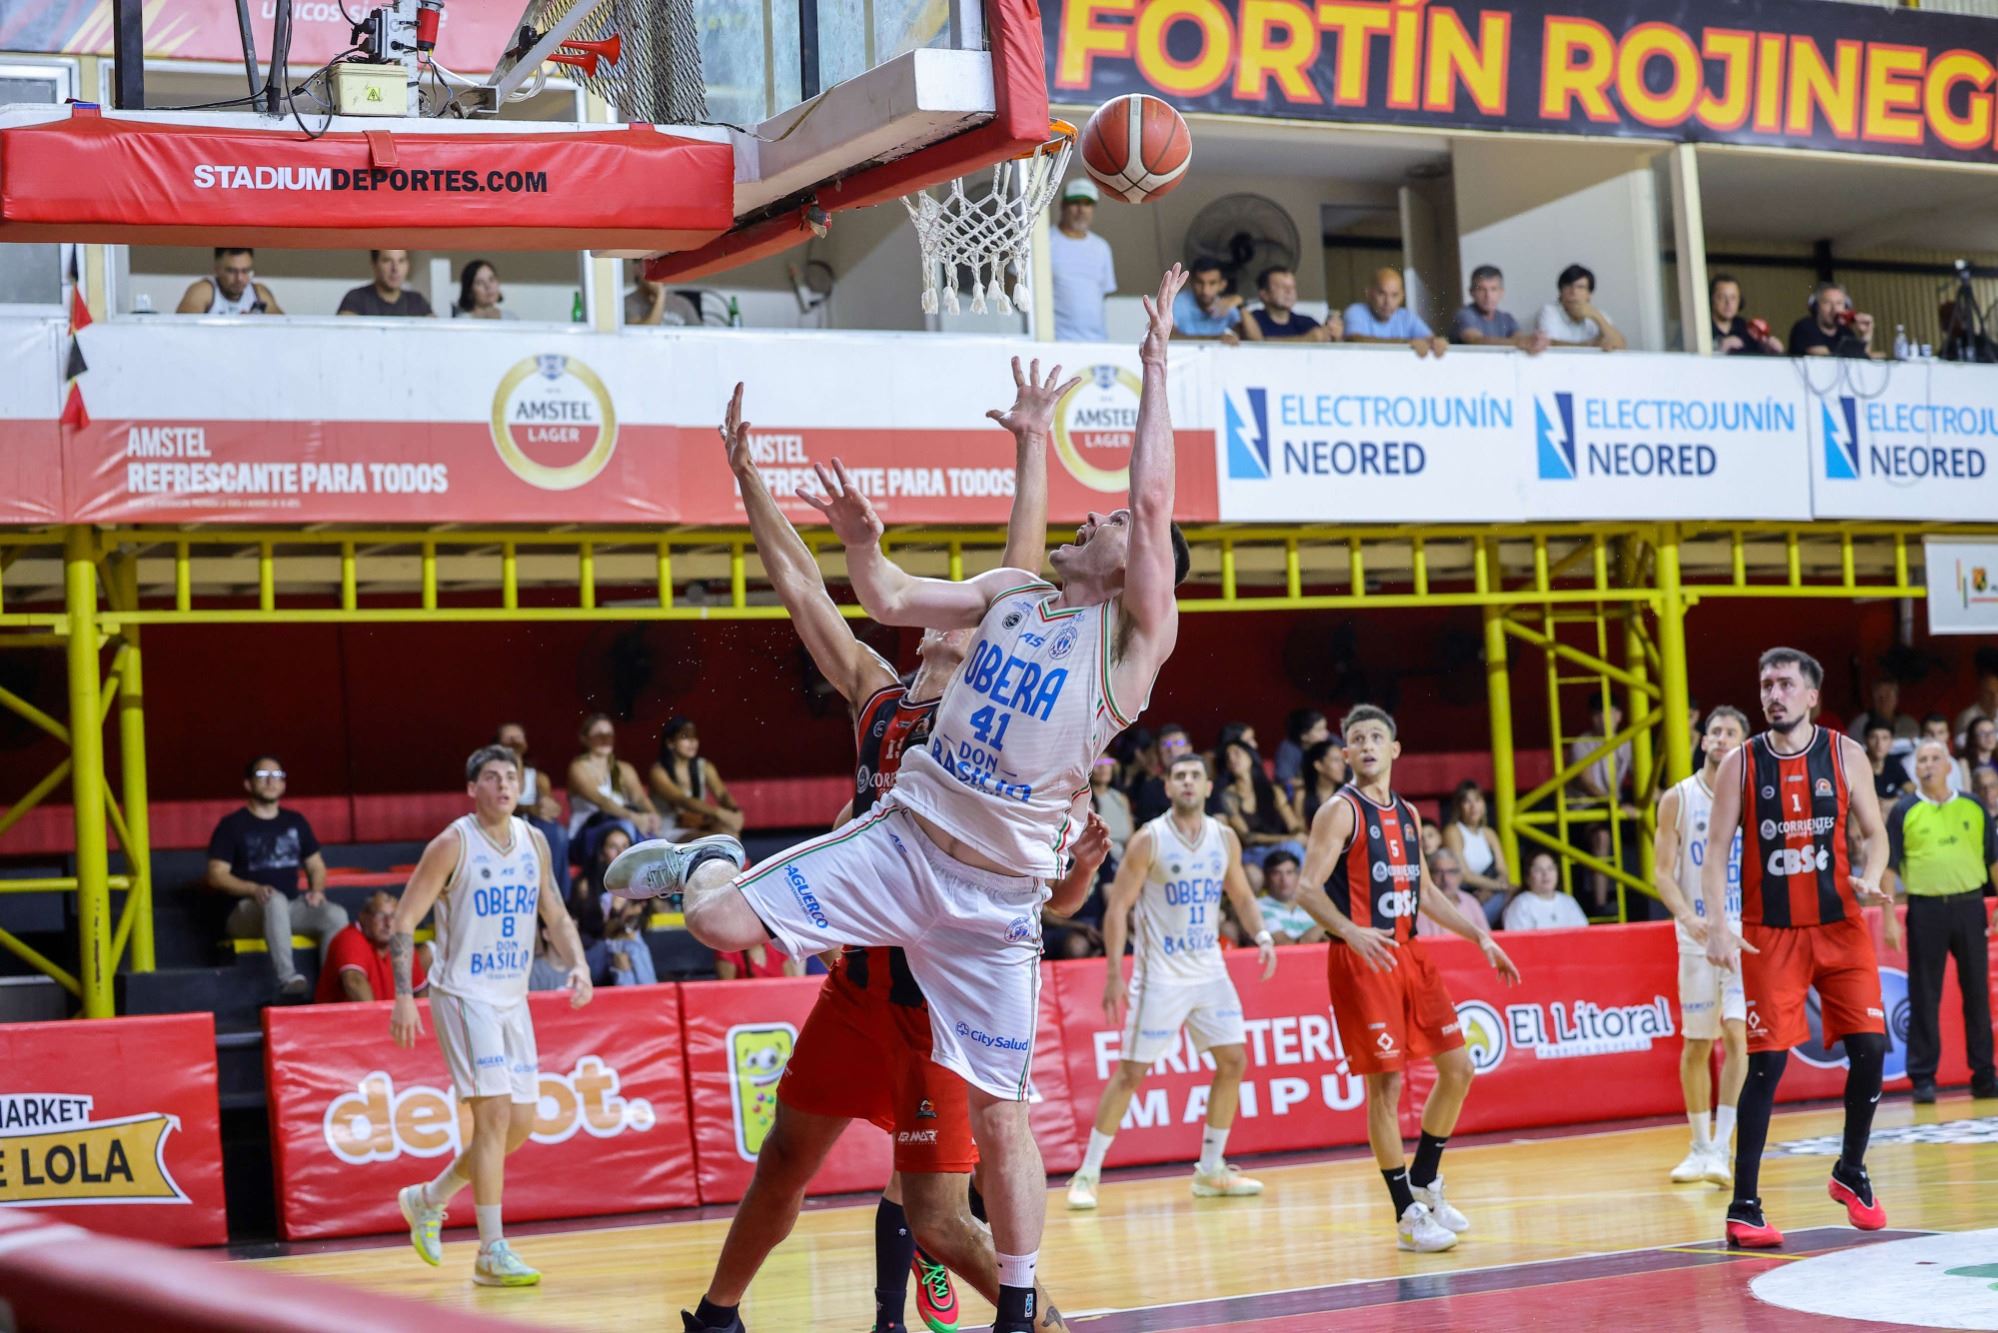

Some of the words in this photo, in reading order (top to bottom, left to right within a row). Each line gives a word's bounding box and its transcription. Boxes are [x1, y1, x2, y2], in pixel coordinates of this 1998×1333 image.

[1054, 0, 1511, 116] FORTÍN
[1539, 15, 1998, 151] ROJINEG
[193, 164, 548, 193] STADIUMDEPORTES.COM
[516, 401, 591, 420] AMSTEL
[1281, 391, 1513, 428] ELECTROJUNÍN
[1586, 396, 1795, 431] ELECTROJUNÍN
[127, 427, 212, 457] AMSTEL
[527, 427, 580, 443] LAGER
[747, 434, 808, 463] MSTEL
[1085, 434, 1131, 449] LAGER
[1284, 441, 1425, 475] NEORED
[1588, 444, 1717, 475] NEORED
[1870, 446, 1986, 478] NEORED
[127, 463, 298, 493] REFRESCANTE
[301, 463, 367, 493] PARA
[369, 463, 449, 493] TODOS
[888, 468, 944, 497] PARA
[948, 468, 1015, 498] TODOS
[964, 639, 1069, 722] OBERA
[970, 705, 1011, 752] 41
[960, 741, 999, 773] DON
[1791, 793, 1802, 812] 1
[1777, 816, 1835, 834] CORRIENTES
[1389, 839, 1400, 858] 5
[474, 885, 537, 917] OBERA
[784, 864, 828, 929] AGUERCO
[1165, 878, 1223, 906] OBERA
[502, 916, 515, 938] 8
[1190, 906, 1204, 924] 11
[1509, 1007, 1545, 1044] El
[1554, 996, 1672, 1042] Litoral
[0, 1098, 88, 1129] ARKET
[20, 1139, 135, 1186] LOLA
